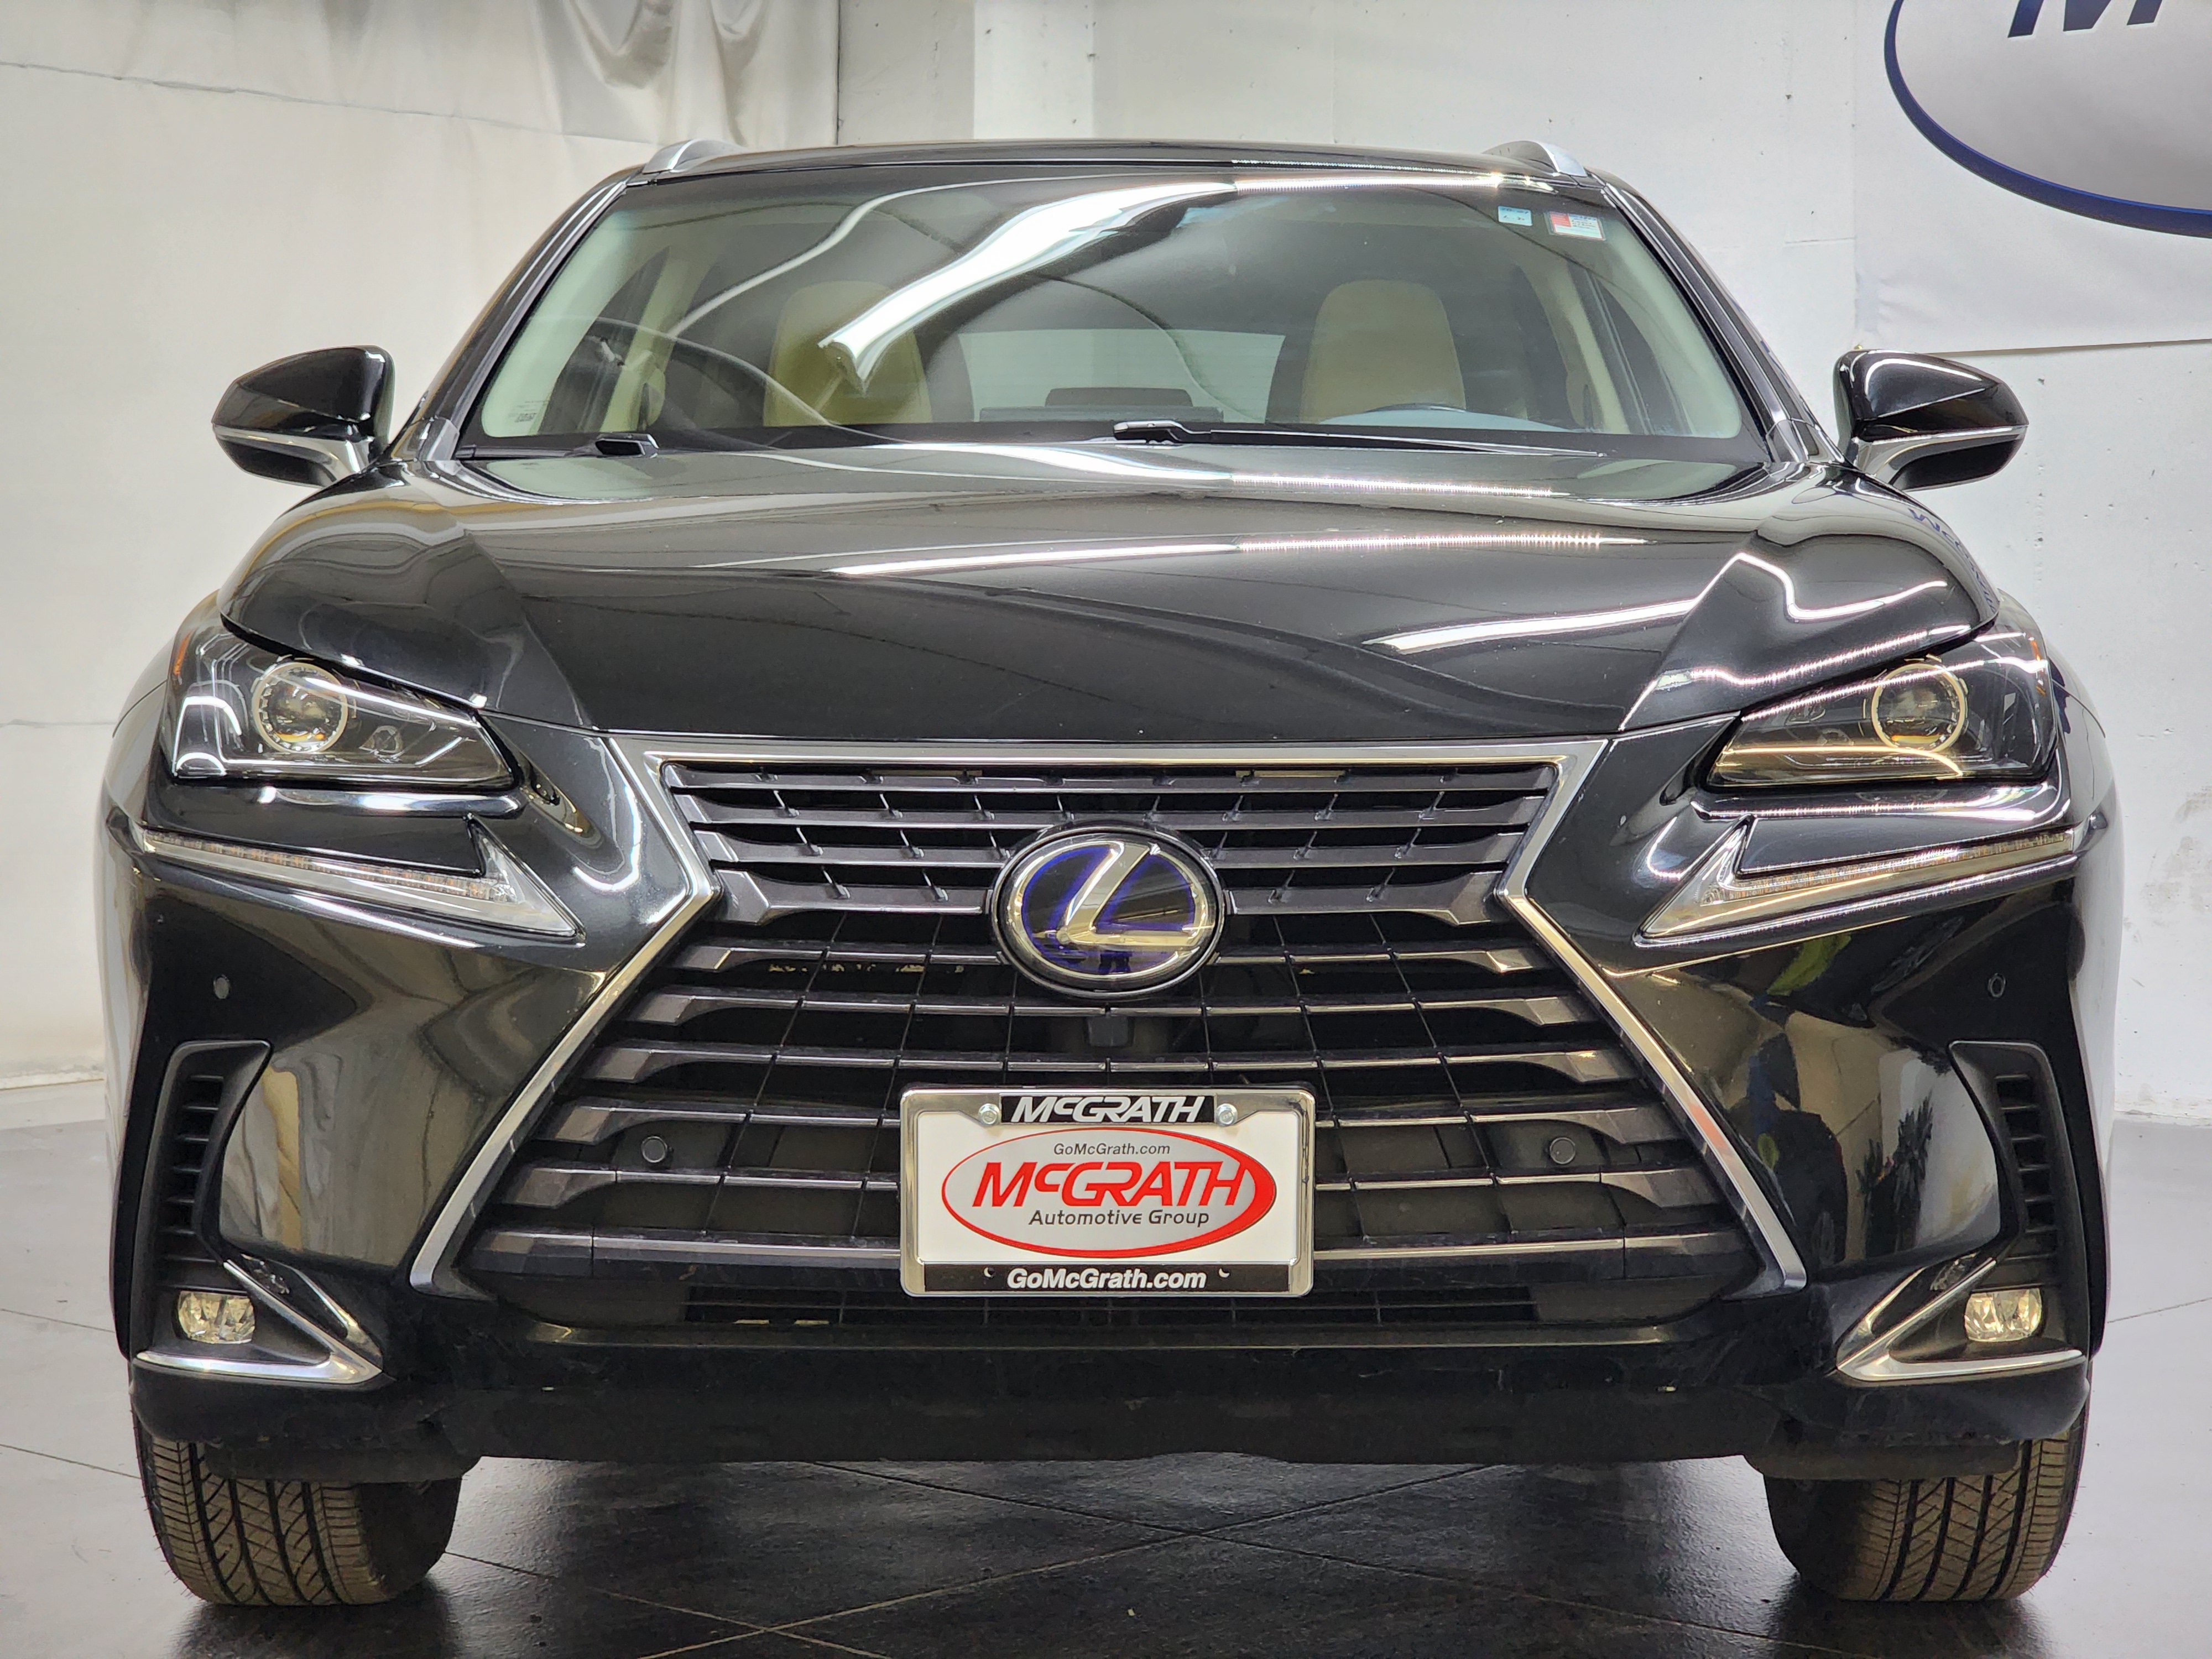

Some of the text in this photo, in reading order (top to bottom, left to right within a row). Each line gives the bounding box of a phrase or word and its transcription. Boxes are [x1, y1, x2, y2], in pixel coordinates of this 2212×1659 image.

[1011, 1096, 1205, 1123] McGRATH
[1053, 1142, 1171, 1156] GoMcGrath.com
[972, 1161, 1244, 1207] McGRATH
[1029, 1209, 1210, 1228] Automotive Group
[1007, 1267, 1207, 1289] GoMcGrath.com
